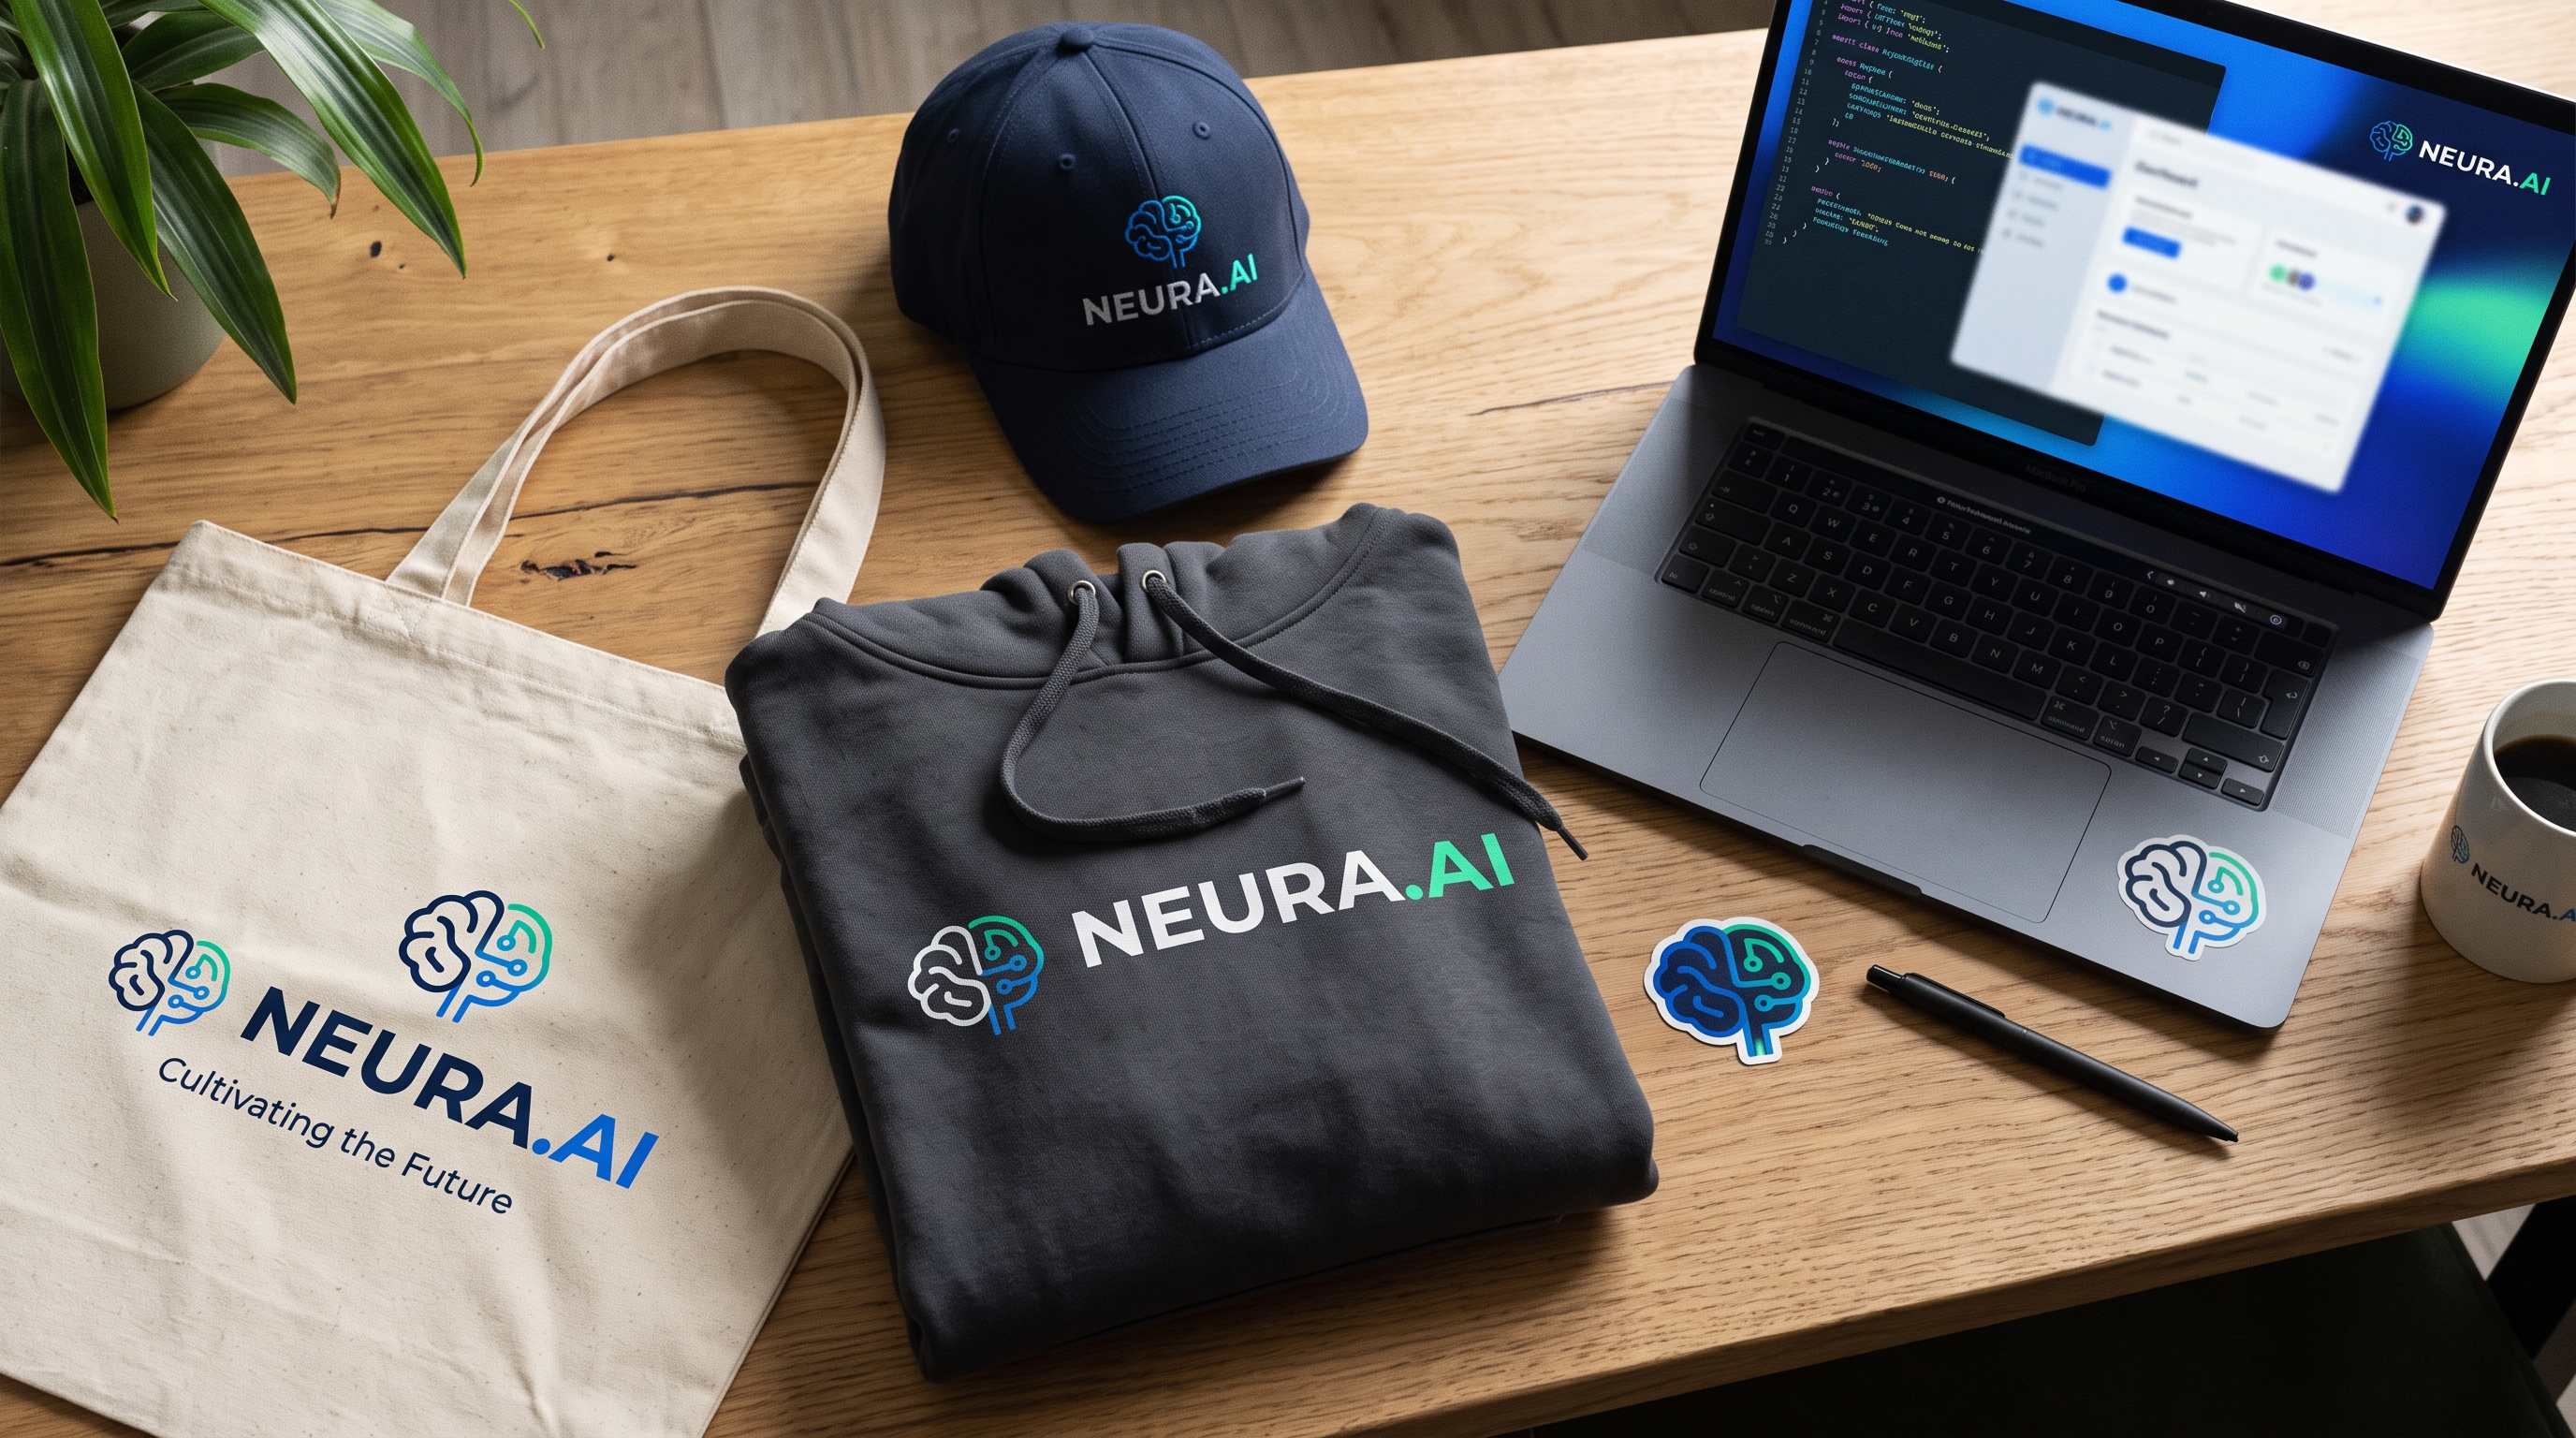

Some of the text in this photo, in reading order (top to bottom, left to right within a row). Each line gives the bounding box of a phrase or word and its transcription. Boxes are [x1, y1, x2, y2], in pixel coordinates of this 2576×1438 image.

[2419, 140, 2551, 196] NEURA.AI
[1082, 254, 1258, 326] NEURA.AI
[1789, 504, 1799, 514] Q
[1828, 517, 1840, 528] W
[1869, 533, 1878, 543] E
[1909, 547, 1918, 558] R
[1952, 562, 1959, 571] T
[1992, 577, 1999, 586] Y
[2031, 591, 2041, 601] U
[2155, 637, 2165, 646] P
[1822, 488, 1831, 497] 2
[1862, 502, 1871, 511] 3
[1942, 531, 1951, 540] 5
[1983, 546, 1991, 555] 6
[1782, 536, 2116, 666] A S D F G H J K L
[1787, 573, 2044, 674] Z X C V B N M
[1071, 833, 1515, 969] NEURA.AI
[158, 1058, 513, 1214] Cultivating the Future
[240, 986, 659, 1189] NEURA.AI
